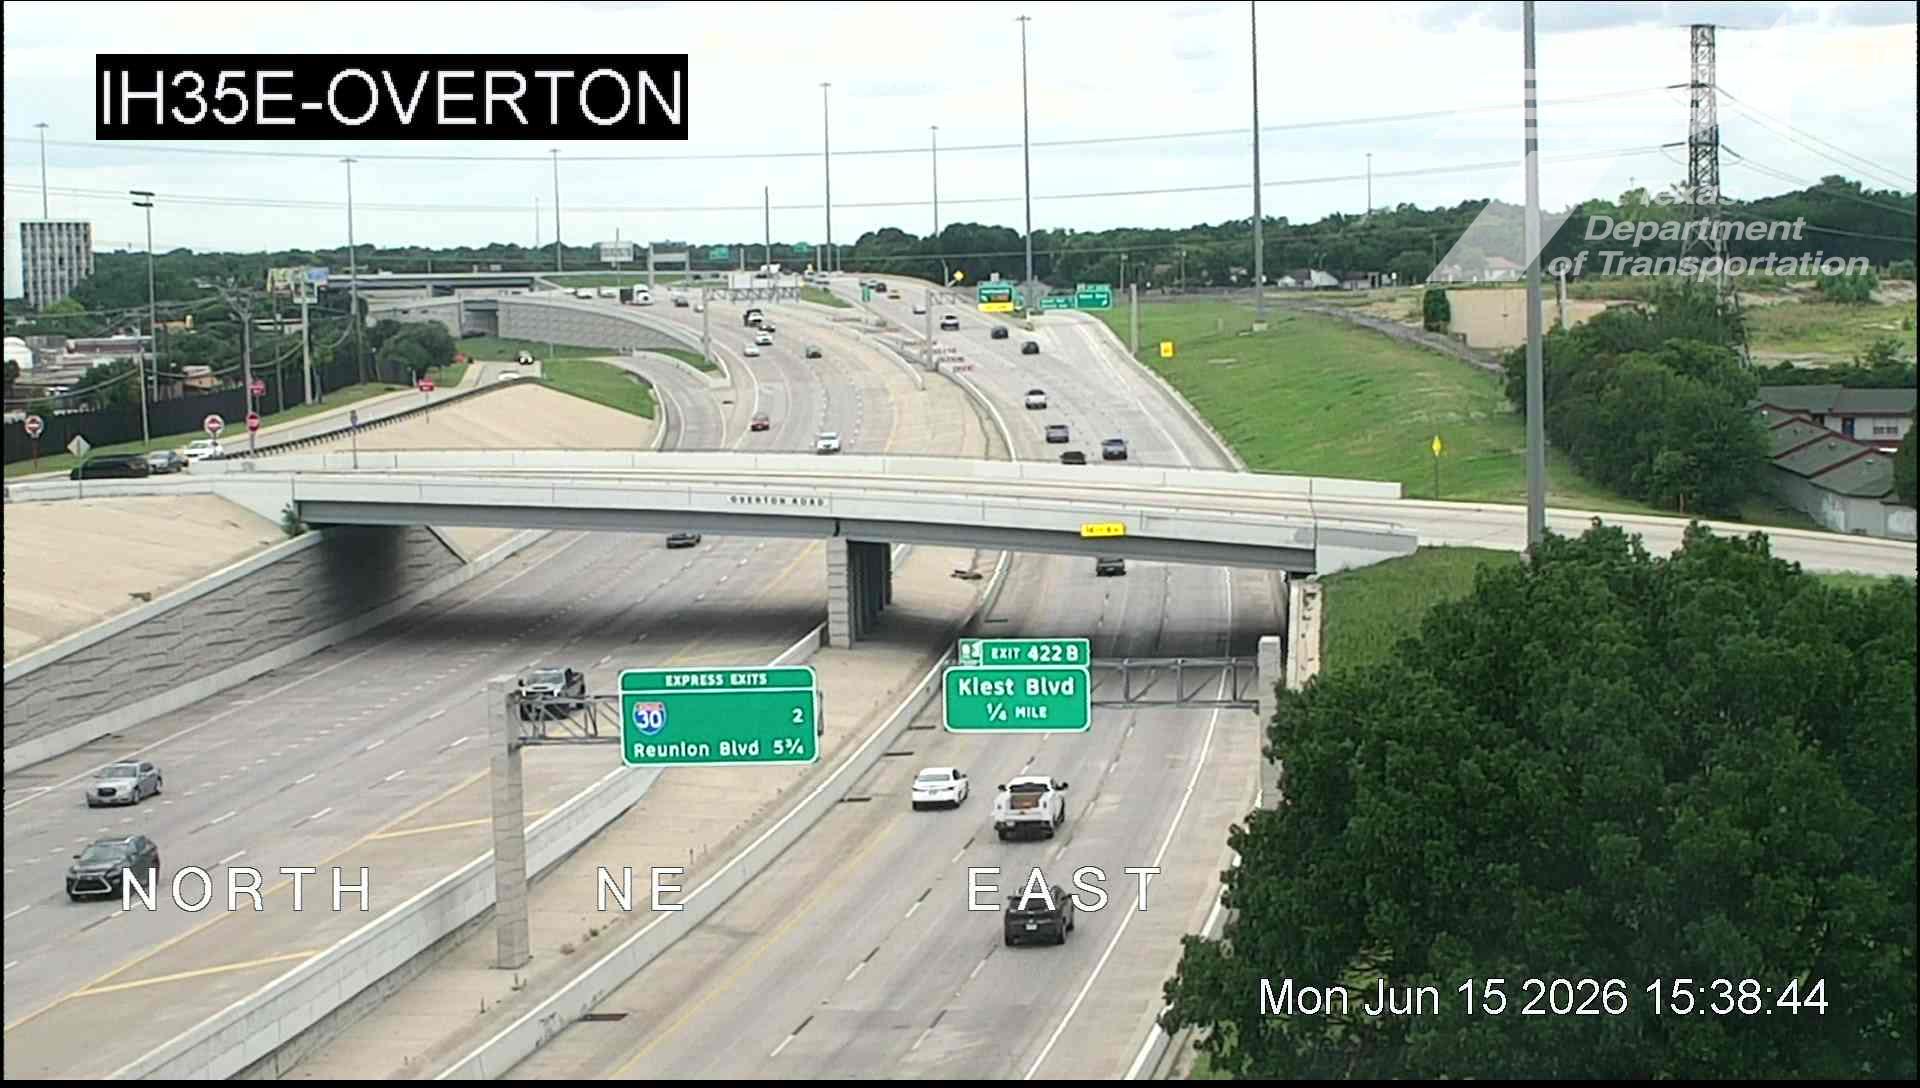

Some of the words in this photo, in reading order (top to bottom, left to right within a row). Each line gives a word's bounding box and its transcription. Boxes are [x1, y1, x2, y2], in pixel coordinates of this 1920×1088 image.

[729, 495, 786, 505] OVERTON
[792, 496, 824, 506] ROAD
[991, 647, 1020, 659] EXIT
[665, 674, 724, 687] EXPRESS
[730, 673, 768, 686] EXITS
[1026, 677, 1075, 696] Blvd
[792, 708, 804, 723] 2
[1015, 706, 1047, 718] MILE
[637, 711, 662, 729] 30
[634, 741, 710, 758] Reunion
[719, 740, 760, 756] Blvd
